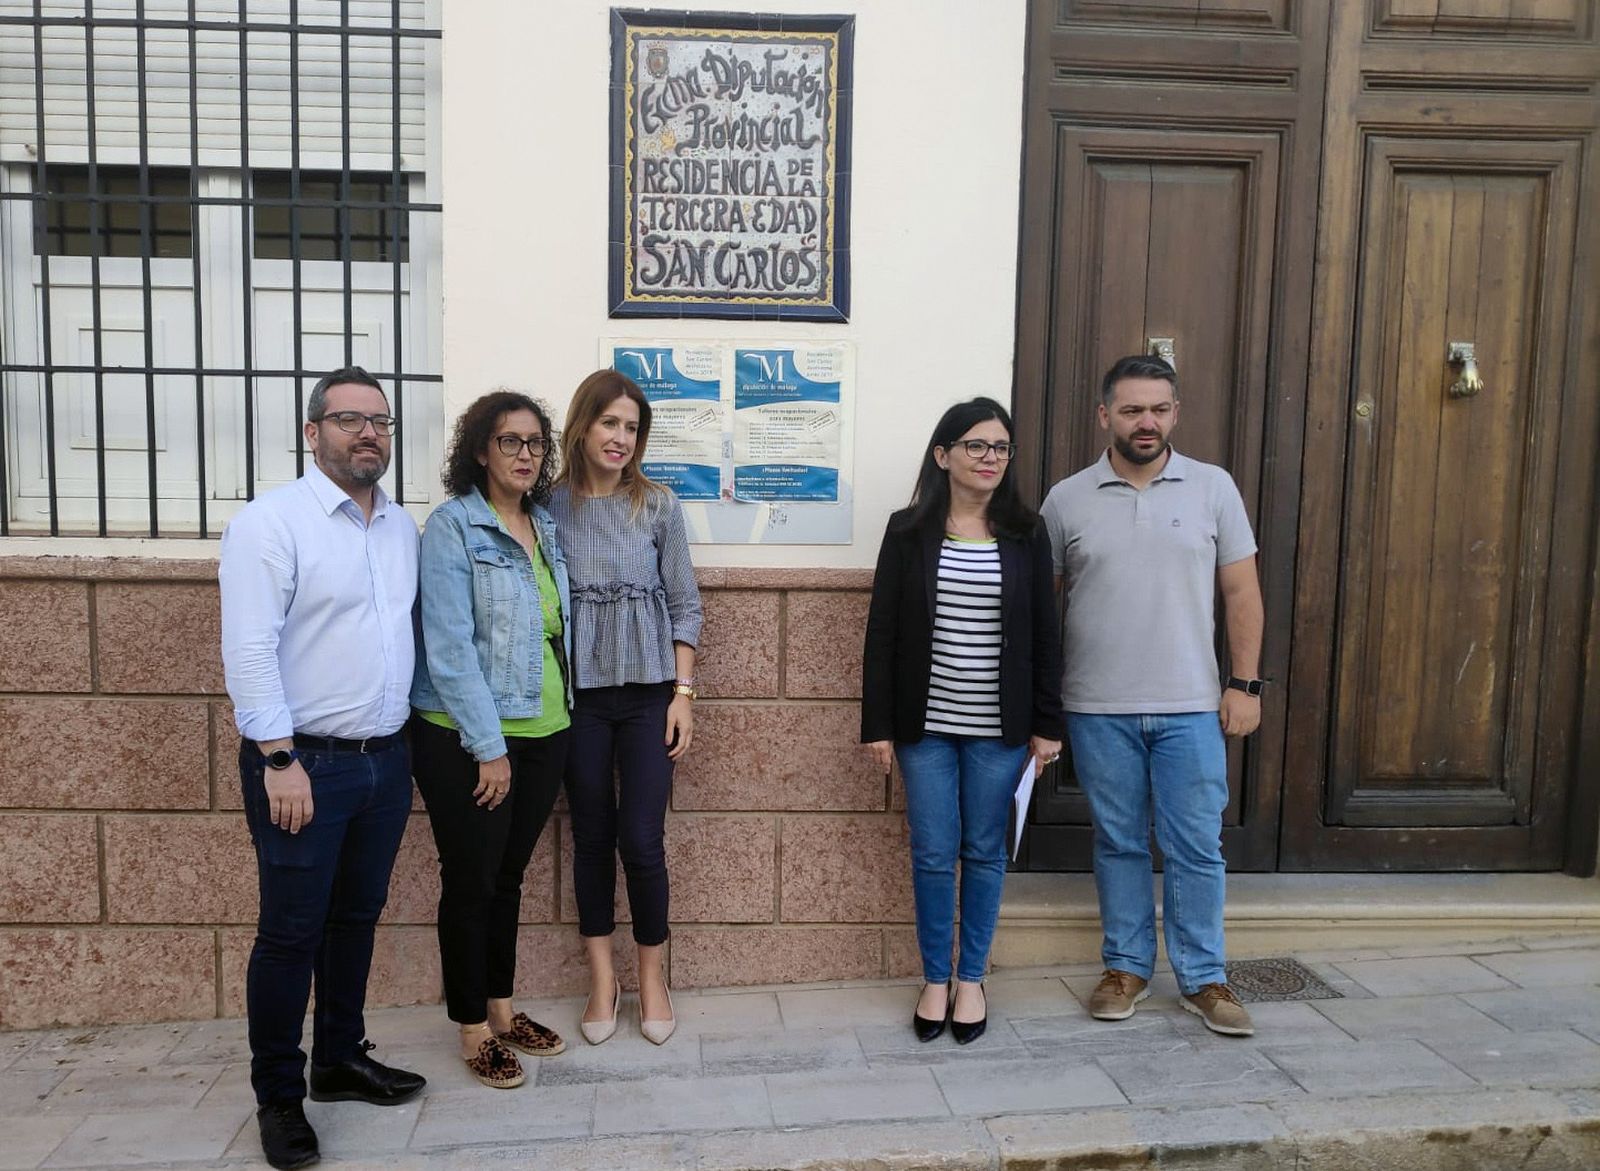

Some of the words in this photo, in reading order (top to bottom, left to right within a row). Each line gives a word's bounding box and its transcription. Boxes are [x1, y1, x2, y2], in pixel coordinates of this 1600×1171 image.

[676, 103, 821, 157] Provincial
[642, 155, 783, 196] RESIDENCIA
[787, 158, 813, 176] DE
[788, 179, 816, 197] LA
[641, 195, 746, 233] TERCERA
[752, 197, 817, 234] EDAD
[640, 234, 714, 288] SAN
[713, 242, 816, 291] CARLOS
[622, 351, 668, 380] M
[743, 353, 785, 382] M
